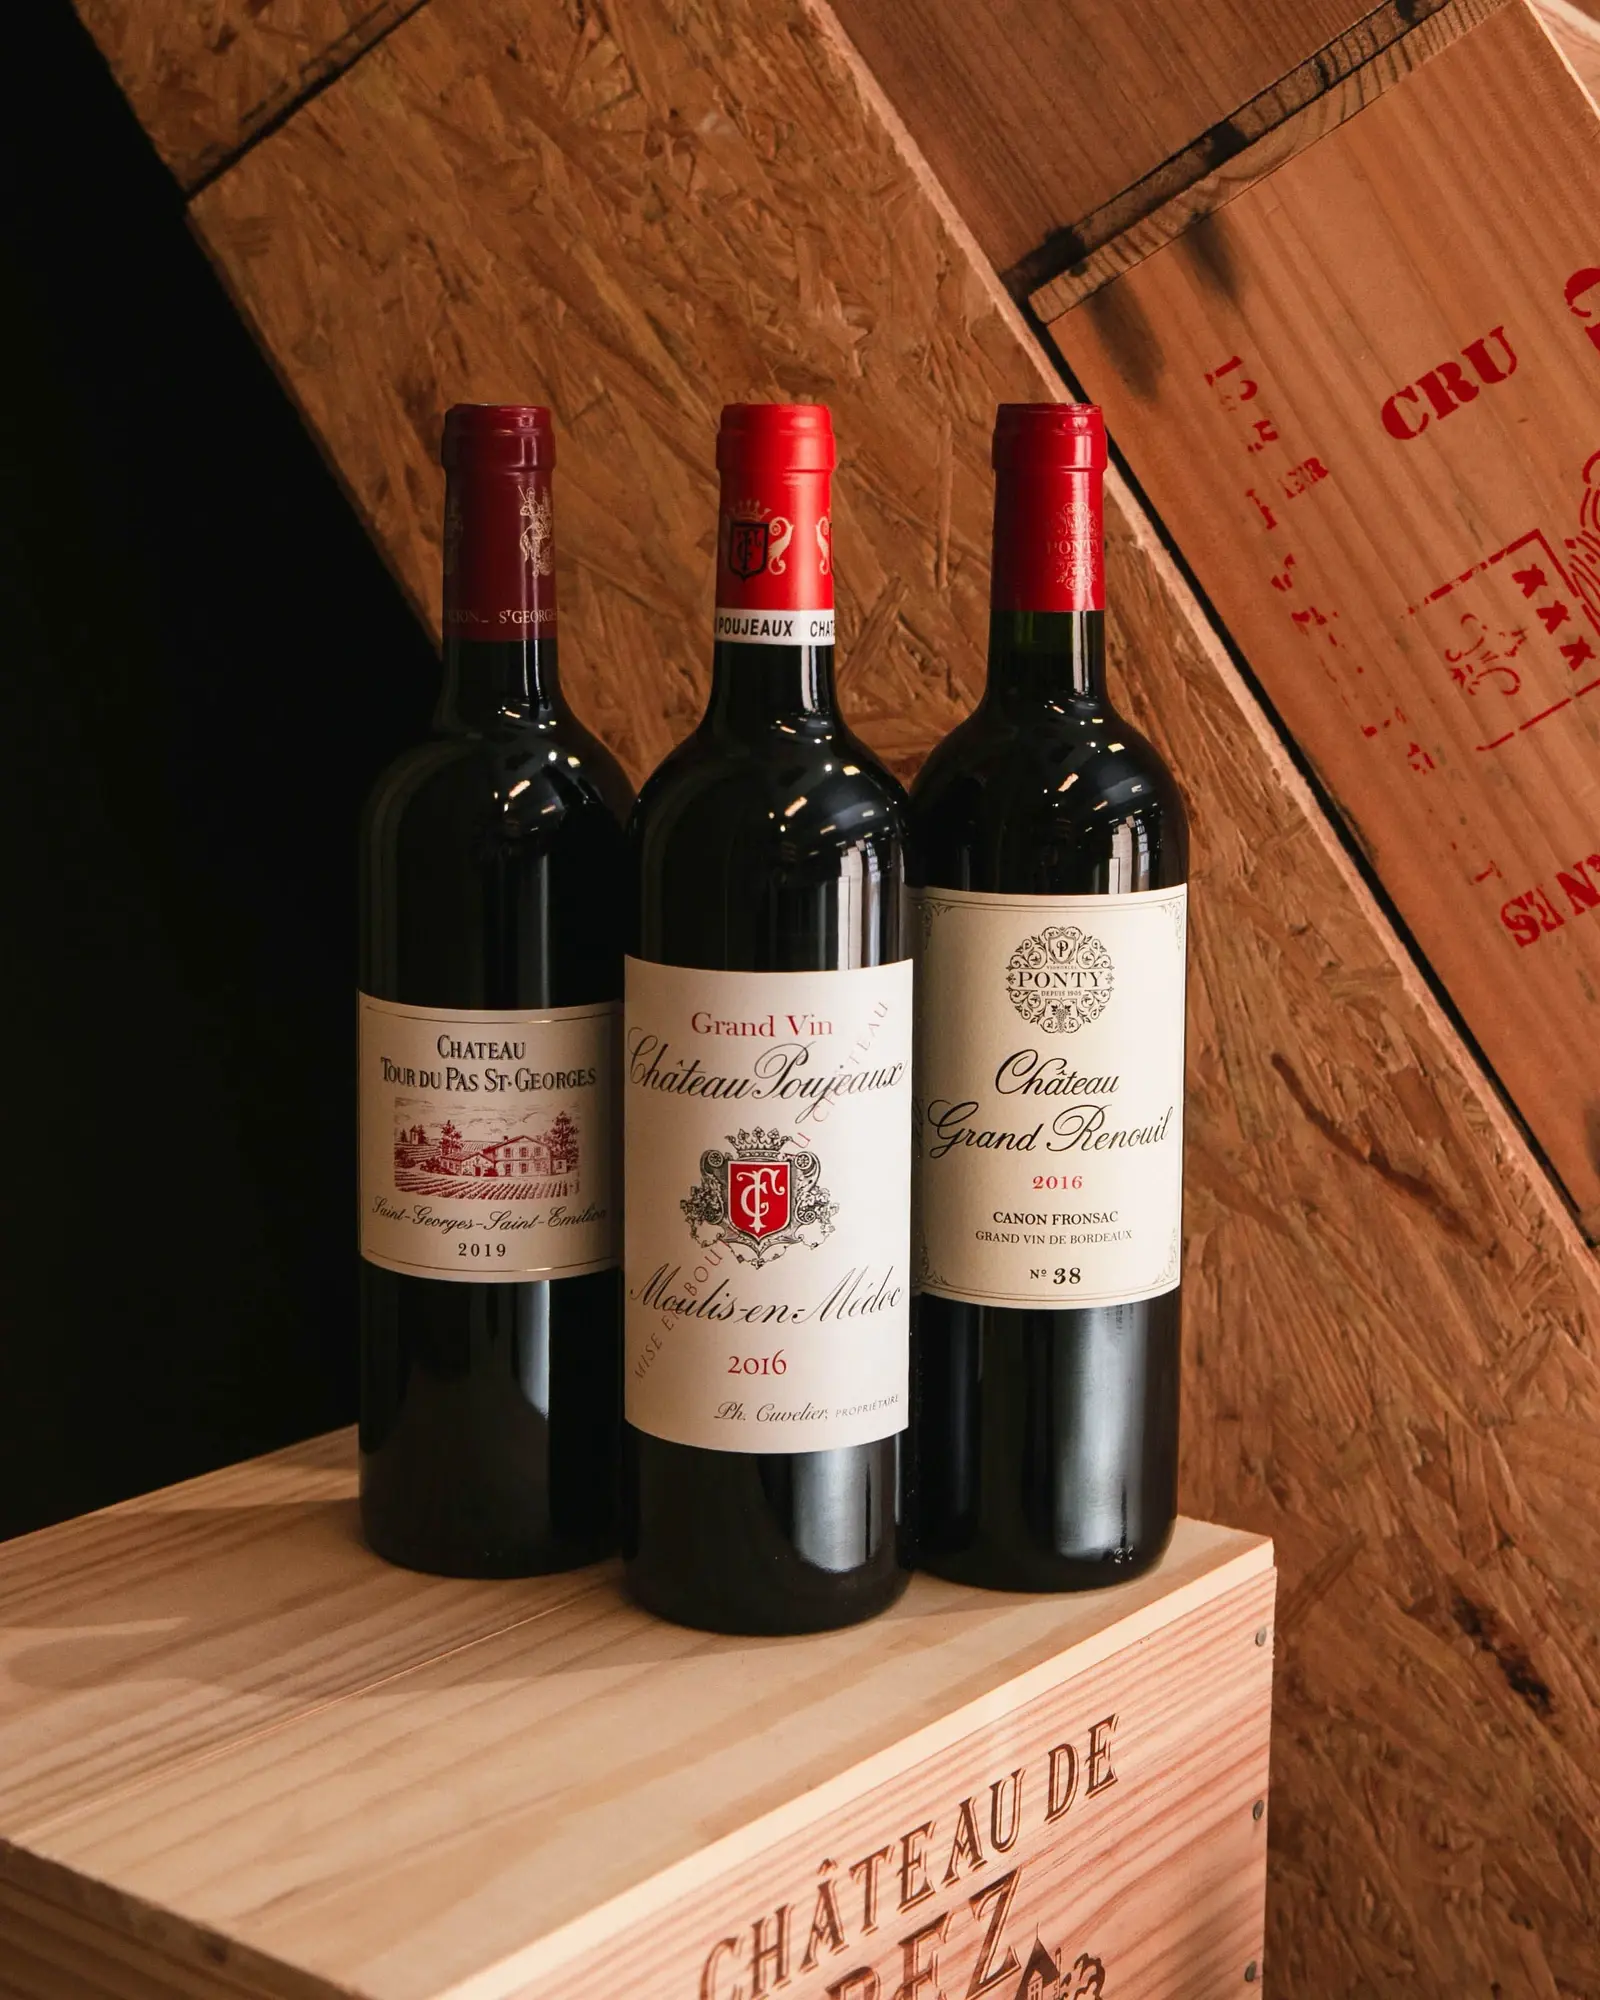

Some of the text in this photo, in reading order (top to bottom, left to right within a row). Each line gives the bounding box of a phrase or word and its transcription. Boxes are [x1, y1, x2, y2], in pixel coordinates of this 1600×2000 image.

[1381, 325, 1517, 440] CRU
[718, 617, 794, 637] POUJEAUX
[1016, 971, 1104, 988] PONTY
[691, 1011, 833, 1038] Grand Vin
[436, 1034, 527, 1061] CHATEAU
[380, 1056, 417, 1087] TOUR
[420, 1070, 441, 1089] DU
[446, 1067, 479, 1091] PAS
[627, 1027, 754, 1099] Château
[752, 1041, 908, 1124] Poujeaux
[995, 1048, 1119, 1096] Château
[927, 1099, 1045, 1160] Grand
[1046, 1104, 1174, 1152] Renouil
[1032, 1174, 1083, 1191] 2016
[993, 1211, 1119, 1226] CANON FRONSAC
[458, 1242, 507, 1258] 2019
[975, 1229, 1133, 1245] GRAND VIN DE BORDEAUX
[1052, 1267, 1082, 1285] 38
[630, 1264, 903, 1325] Moulis-en-Médoc
[727, 1349, 788, 1376] 2016
[713, 1401, 747, 1422] Ph.
[700, 1713, 1120, 2000] CHÂTEAU DE
